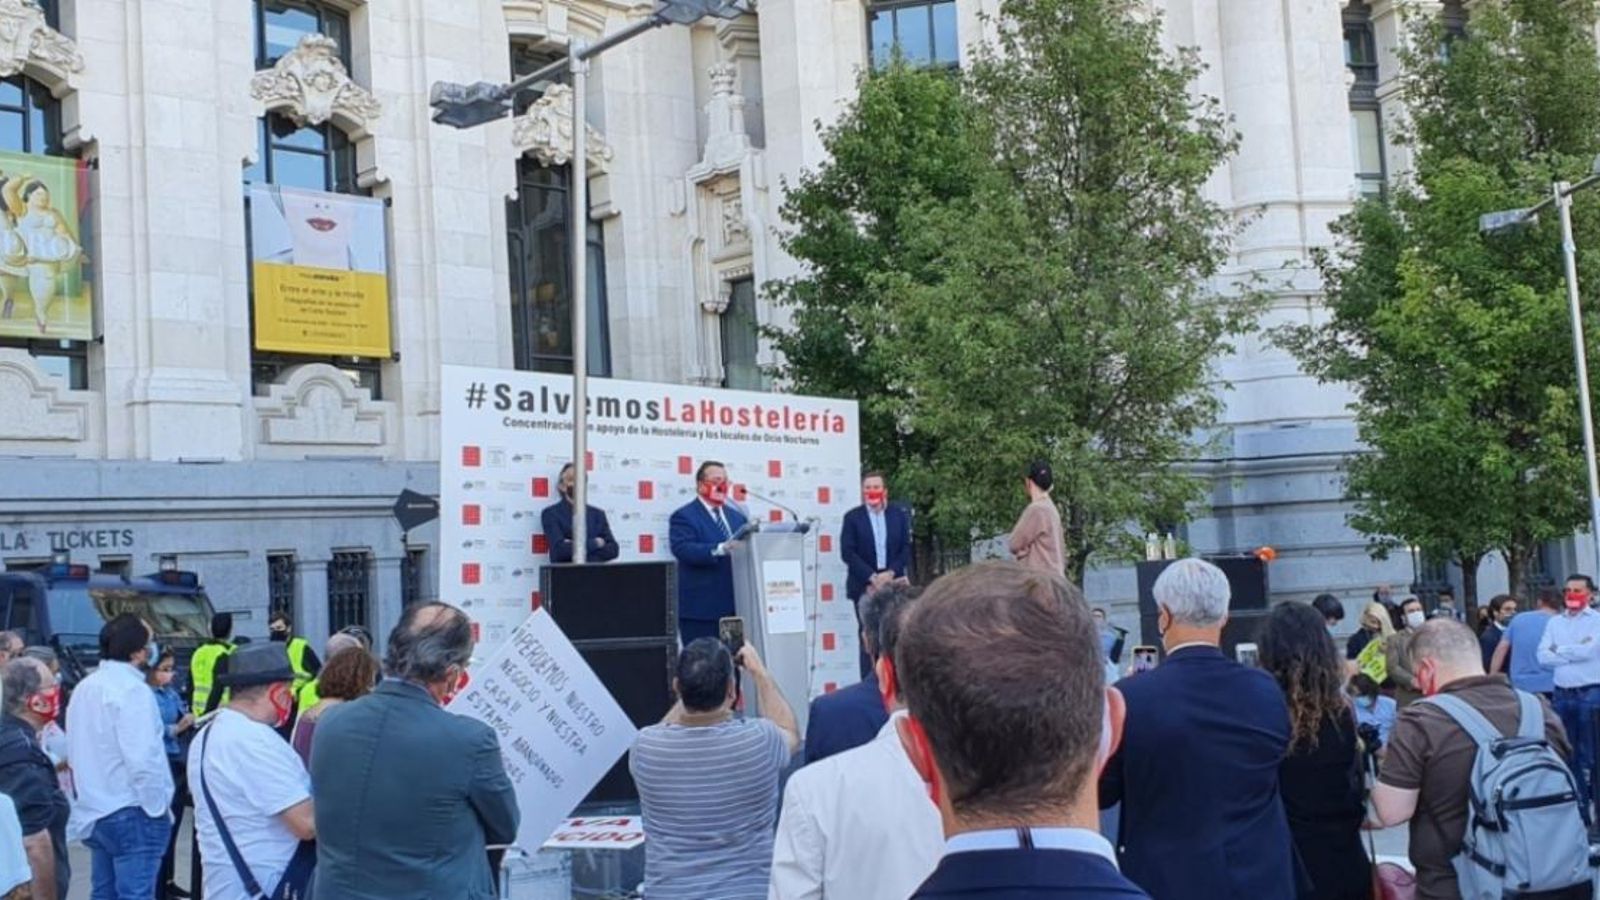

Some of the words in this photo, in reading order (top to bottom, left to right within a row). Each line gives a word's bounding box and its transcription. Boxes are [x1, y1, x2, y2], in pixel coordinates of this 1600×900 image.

[502, 416, 577, 430] Concentració
[627, 425, 638, 434] de
[641, 425, 649, 434] la
[699, 431, 704, 440] y
[705, 429, 719, 439] los
[720, 430, 750, 440] locales
[752, 433, 762, 442] de
[47, 529, 134, 550] TICKETS
[500, 658, 541, 703] NEGOCIO
[537, 700, 551, 713] Y
[546, 709, 589, 756] NUESTRA
[565, 690, 606, 737] NUESTRO
